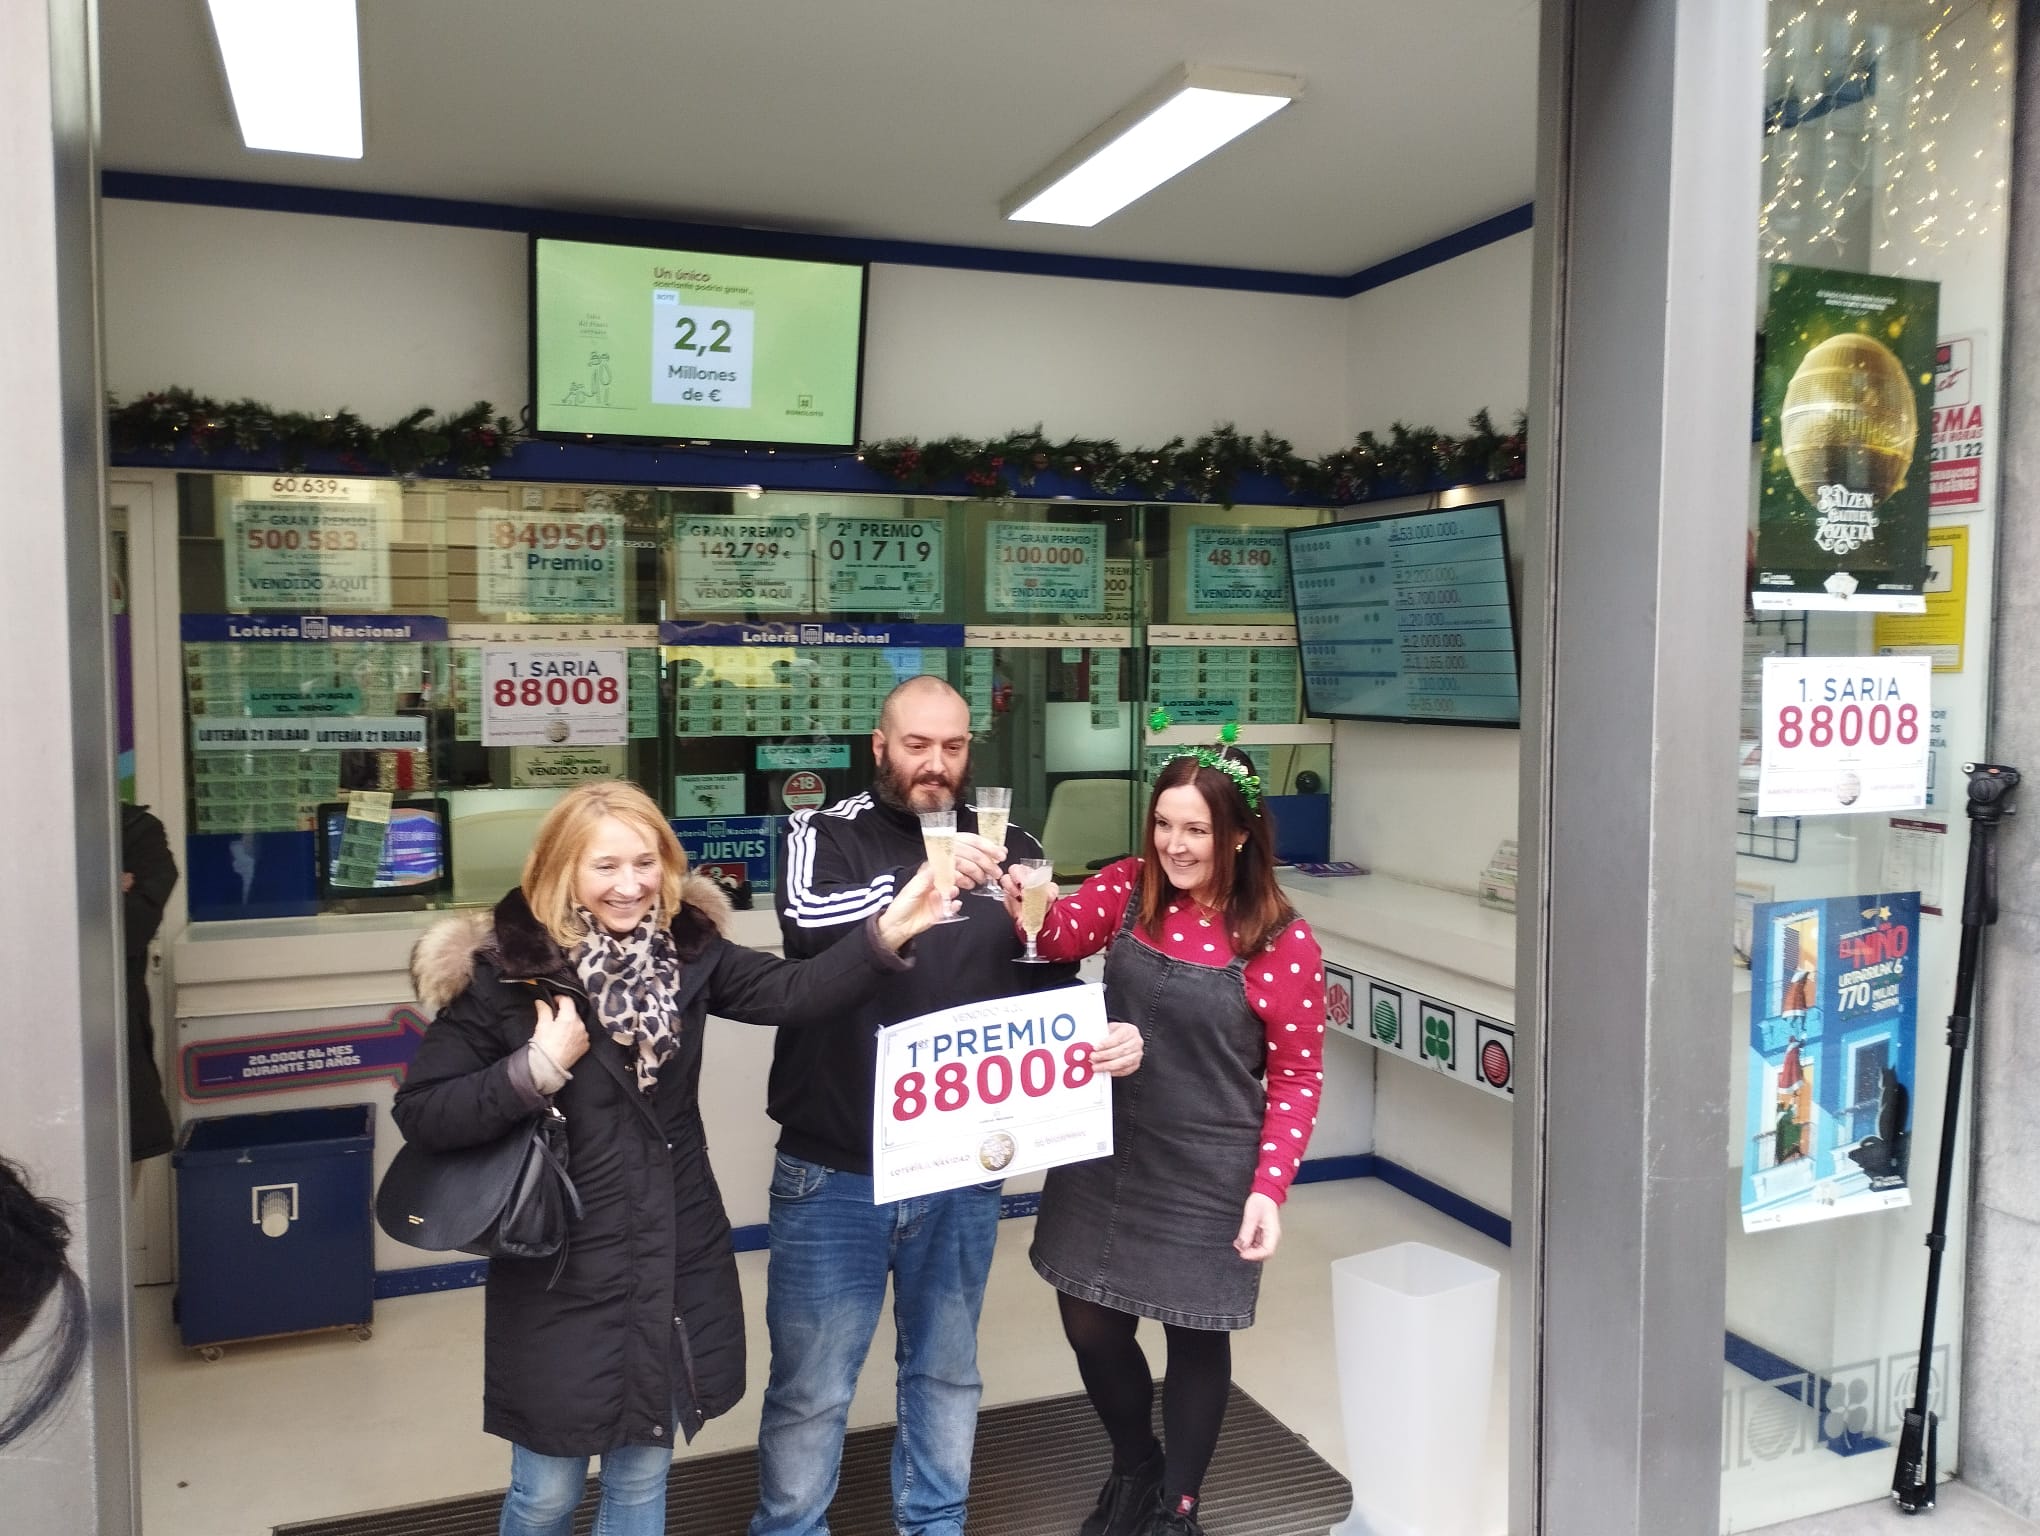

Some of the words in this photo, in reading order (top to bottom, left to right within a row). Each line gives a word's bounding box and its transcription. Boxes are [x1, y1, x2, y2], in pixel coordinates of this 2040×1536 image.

[653, 266, 673, 279] Un
[676, 269, 711, 282] único
[674, 317, 732, 357] 2,2
[667, 365, 737, 382] Millones
[682, 388, 703, 401] de
[708, 389, 722, 402] €
[273, 478, 338, 493] 60.639
[495, 521, 607, 551] 84950
[690, 525, 736, 538] GRAN
[740, 526, 796, 538] PREMIO
[859, 524, 923, 538] PREMIO
[1019, 534, 1049, 544] GRAN
[1050, 535, 1091, 545] PREMIO
[829, 539, 931, 562] 01719
[1003, 546, 1084, 565] 100.000
[1207, 549, 1271, 566] 48.180
[527, 554, 603, 572] Premio
[248, 578, 323, 590] VENDIDO
[695, 588, 756, 599] VENDIDO
[1201, 589, 1252, 599] VENDIDO
[229, 625, 299, 638] Lotería
[329, 625, 411, 638] Nacional
[742, 631, 799, 644] Lotería
[823, 632, 890, 644] Nacional
[530, 660, 602, 678] SARIA
[493, 676, 619, 707] 88008
[1823, 677, 1902, 702] SARIA
[1777, 703, 1919, 749] 88008
[250, 729, 265, 742] 21
[267, 729, 310, 741] BILBAO
[365, 729, 379, 742] 21
[381, 730, 422, 742] BILBAO
[527, 765, 578, 776] VENDIDO
[791, 776, 816, 790] +18
[677, 829, 708, 837] otería
[727, 827, 769, 835] Nacional
[700, 840, 766, 860] JUEVES
[1838, 982, 1871, 1012] 770
[932, 1013, 1077, 1062] PREMIO
[306, 1048, 326, 1059] AL
[326, 1045, 354, 1057] MES
[242, 1061, 305, 1078] DURANTE
[306, 1059, 325, 1070] 30
[325, 1055, 361, 1068] AÑOS
[892, 1041, 1096, 1122] 88008
